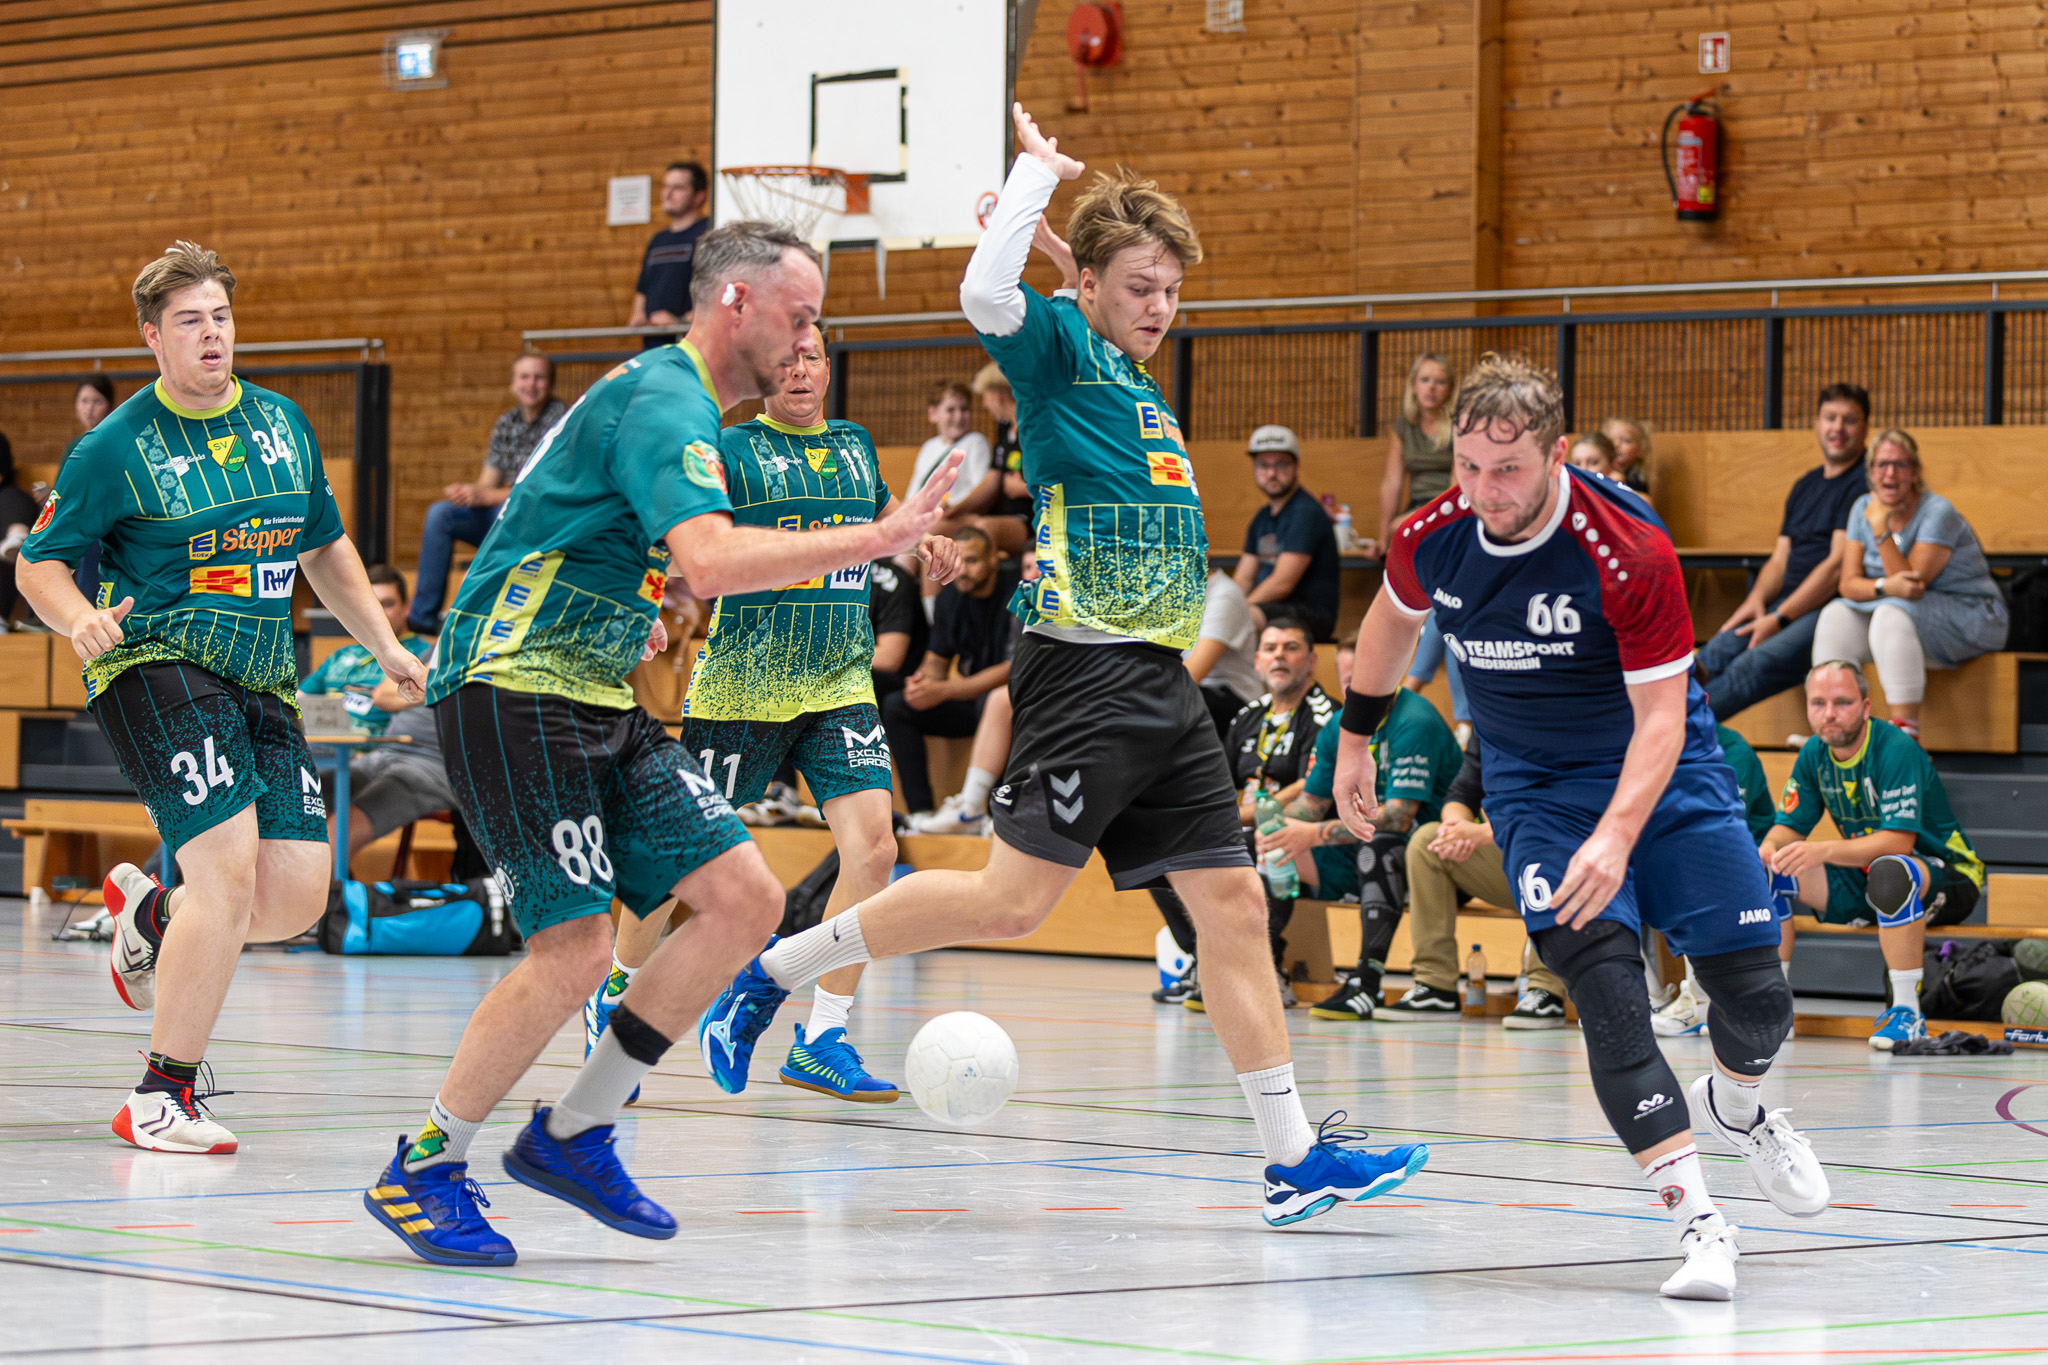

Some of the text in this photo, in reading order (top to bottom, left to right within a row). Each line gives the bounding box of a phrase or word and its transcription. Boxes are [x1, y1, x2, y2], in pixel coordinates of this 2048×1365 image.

[213, 441, 228, 451] SV
[252, 427, 293, 465] 34
[840, 448, 870, 482] 11
[221, 527, 302, 557] Stepper
[263, 567, 297, 592] R+V
[1433, 587, 1463, 610] JAKO
[1526, 593, 1582, 637] 66
[1462, 640, 1575, 659] TEAMSPORT
[1469, 656, 1541, 671] NIEDERRHEIN
[170, 735, 235, 806] 34
[700, 748, 742, 800] 11
[552, 814, 614, 885] 88
[1518, 863, 1553, 916] 6
[1738, 908, 1772, 926] JAKO
